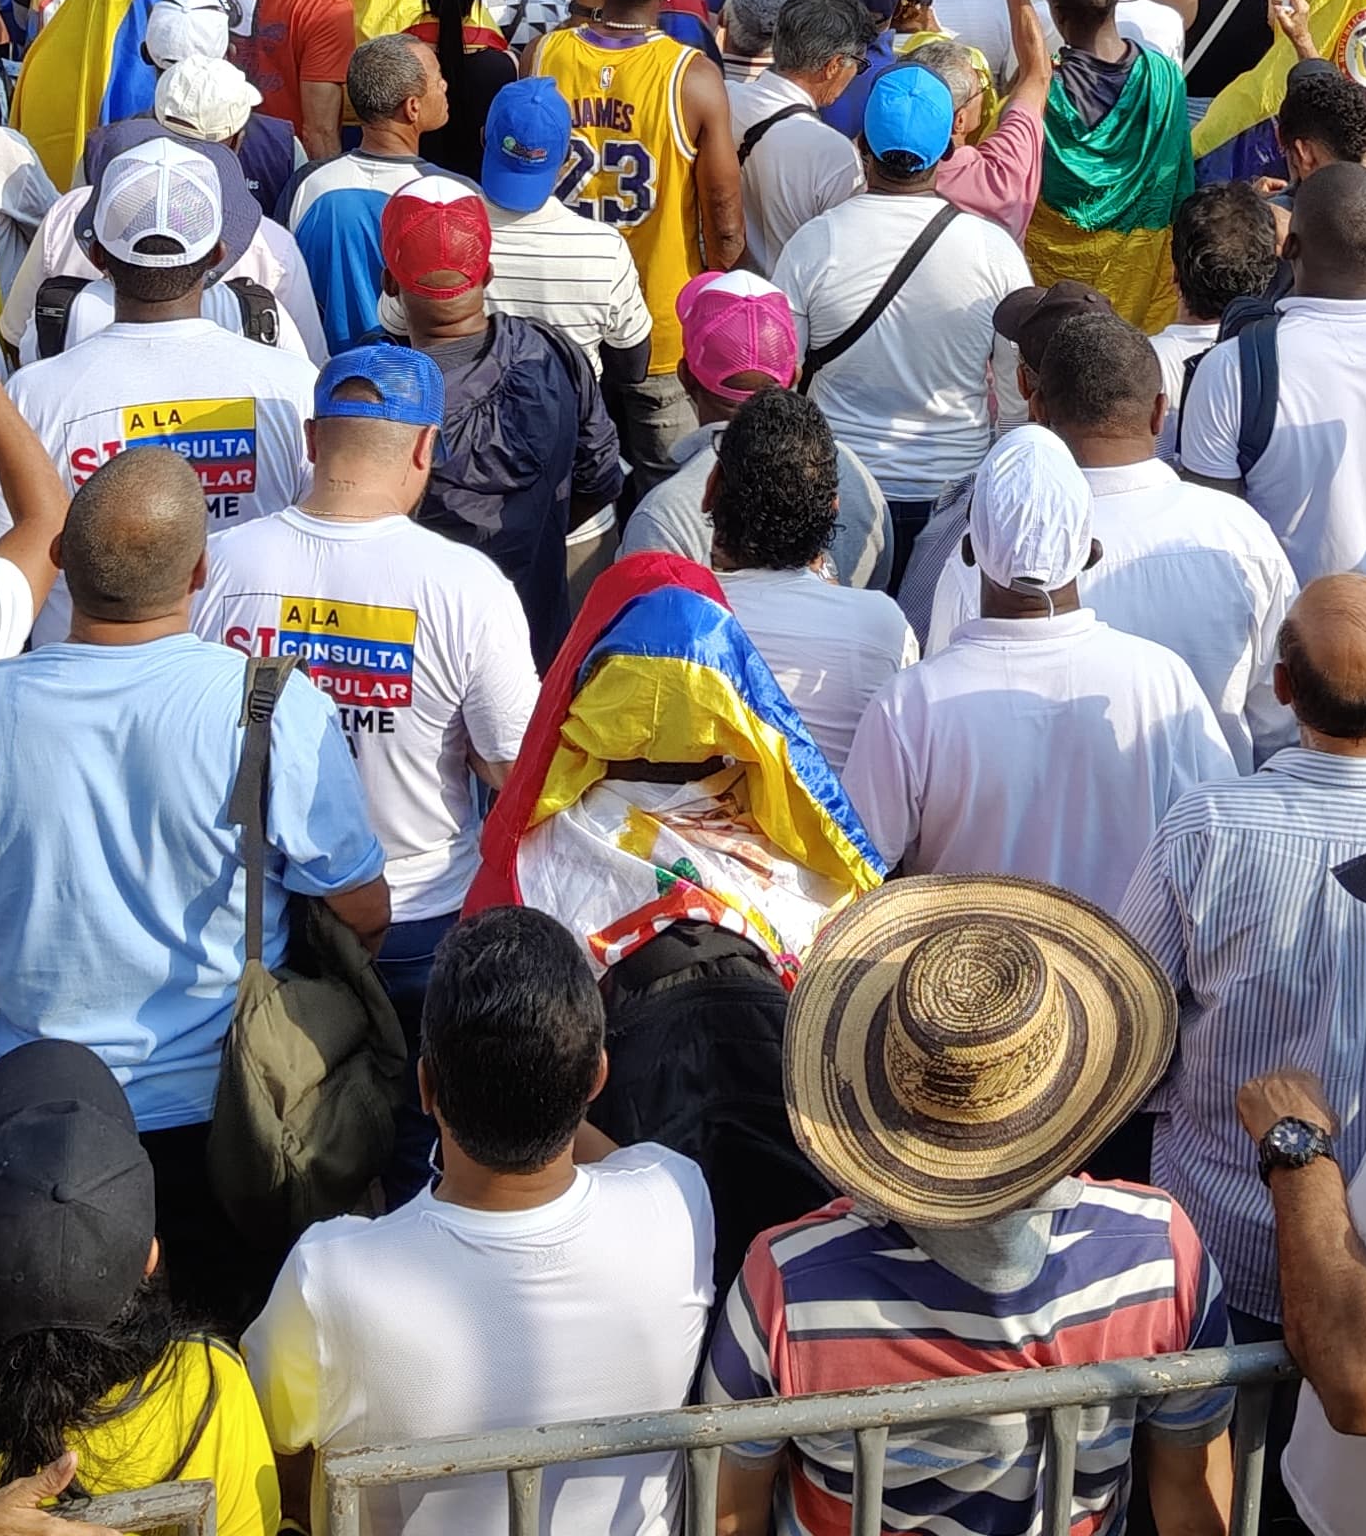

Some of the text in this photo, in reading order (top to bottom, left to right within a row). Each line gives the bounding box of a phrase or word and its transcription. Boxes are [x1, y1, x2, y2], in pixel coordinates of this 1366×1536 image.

[571, 96, 635, 133] JAMES
[555, 136, 657, 227] 23
[130, 409, 183, 432] A LA
[286, 605, 340, 628] A LA
[280, 639, 408, 670] CONSULTA
[312, 675, 409, 700] PULAR
